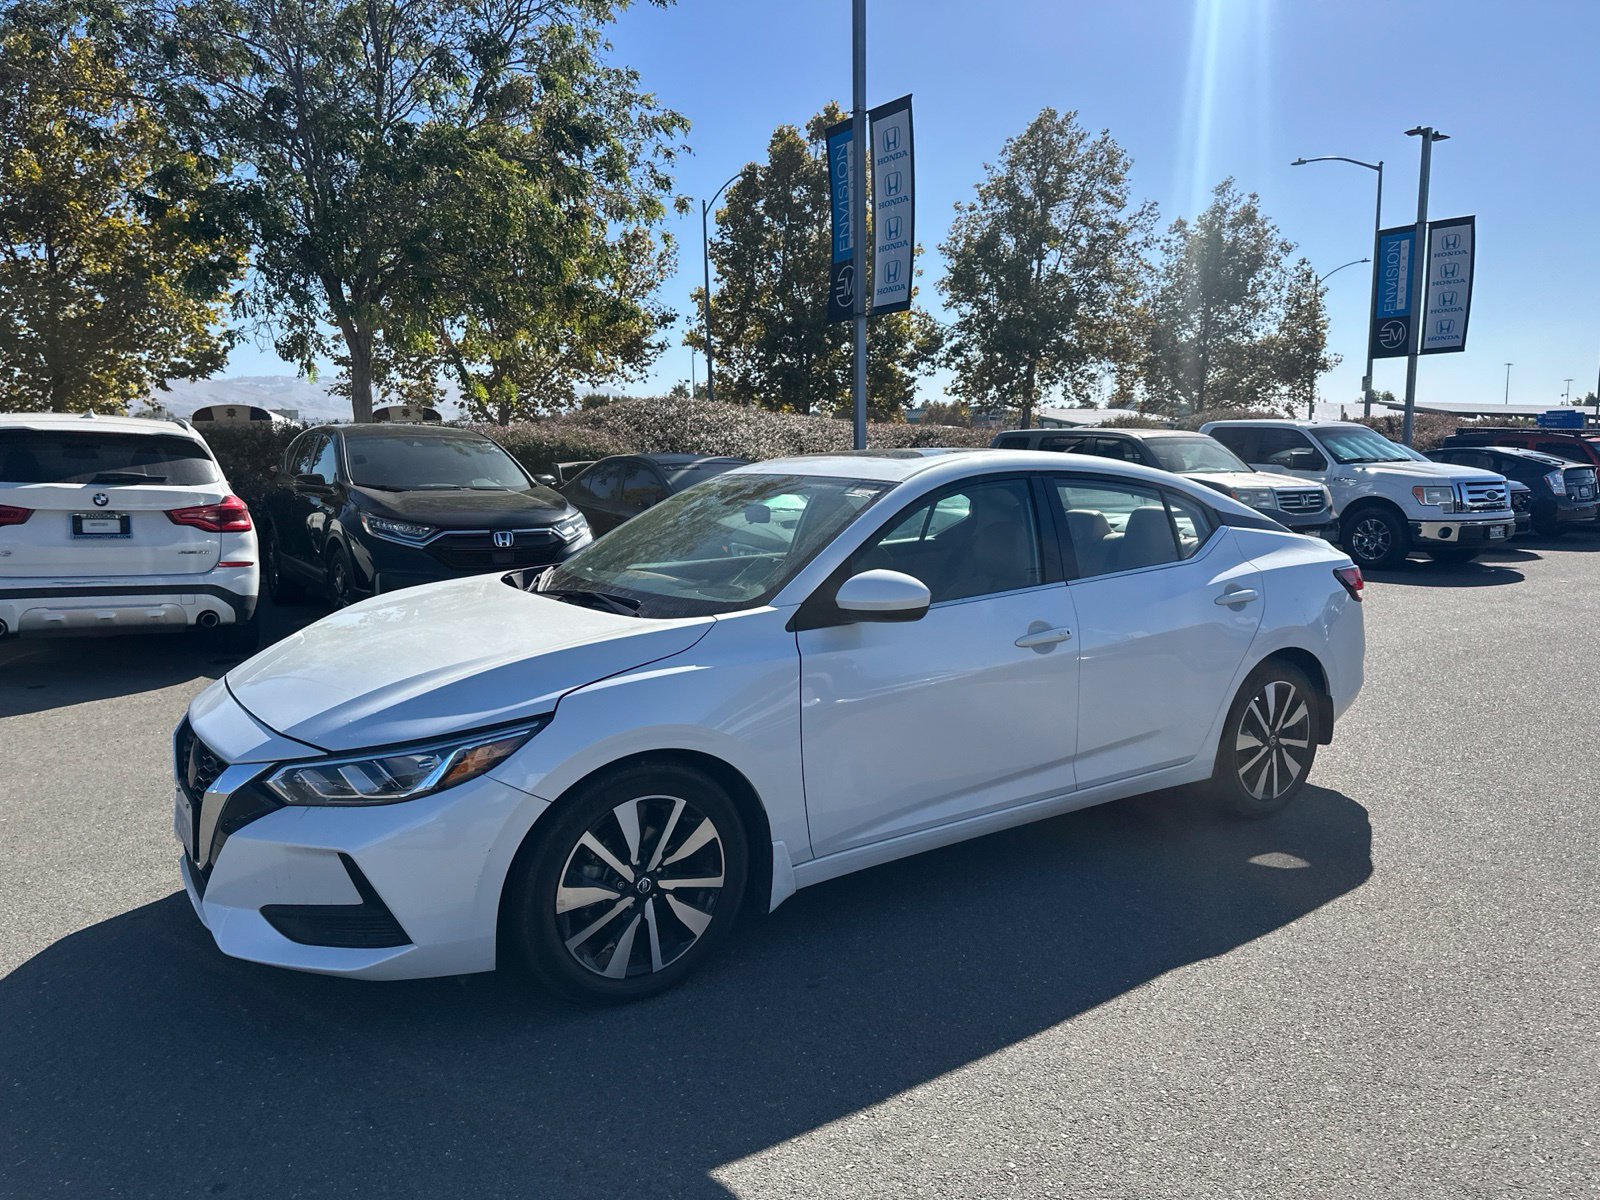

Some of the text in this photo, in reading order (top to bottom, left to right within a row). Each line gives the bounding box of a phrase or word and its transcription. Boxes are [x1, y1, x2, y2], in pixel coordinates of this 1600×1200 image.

[877, 150, 908, 165] HONDA
[836, 143, 849, 252] ENVISION
[878, 196, 909, 209] HONDA
[878, 240, 908, 253] HONDA
[1434, 249, 1468, 257] HONDA
[1384, 240, 1400, 312] ENVISION
[1432, 278, 1466, 286] HONDA
[877, 284, 906, 295] HONDA
[1430, 306, 1464, 314] HONDA
[1427, 334, 1460, 342] HONDA
